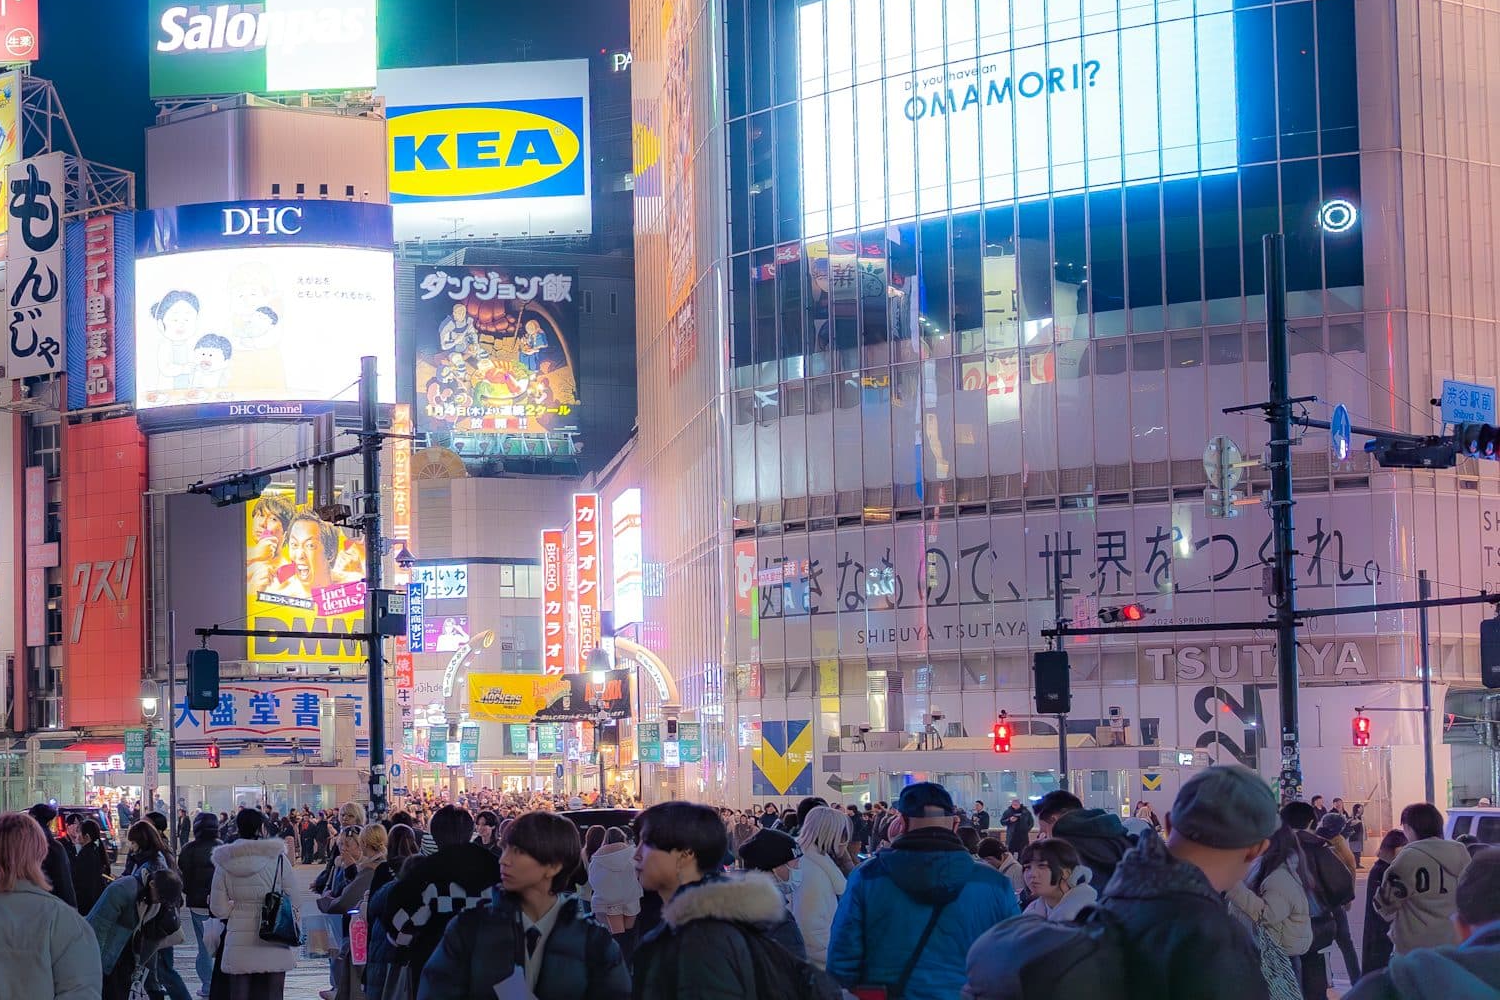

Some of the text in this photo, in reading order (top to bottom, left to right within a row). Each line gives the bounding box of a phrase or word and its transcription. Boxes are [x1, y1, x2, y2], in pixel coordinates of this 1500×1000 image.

[949, 67, 978, 83] have
[981, 63, 997, 75] an
[904, 59, 1101, 122] OMAMORI?
[393, 128, 563, 173] KEA
[222, 206, 303, 237] DHC
[9, 163, 60, 369] もんじゃ
[419, 271, 573, 303] ダンジョン飯
[229, 403, 303, 415] DHC Channel
[1446, 386, 1492, 411] 渋谷駅前
[577, 505, 597, 595] カラオケ
[422, 567, 466, 582] れいわ
[410, 586, 422, 649] 大盛堂商事ビル
[857, 625, 934, 645] SHIBUYA
[944, 620, 1029, 640] TSUTAYA
[1145, 640, 1369, 681] TSUTYA
